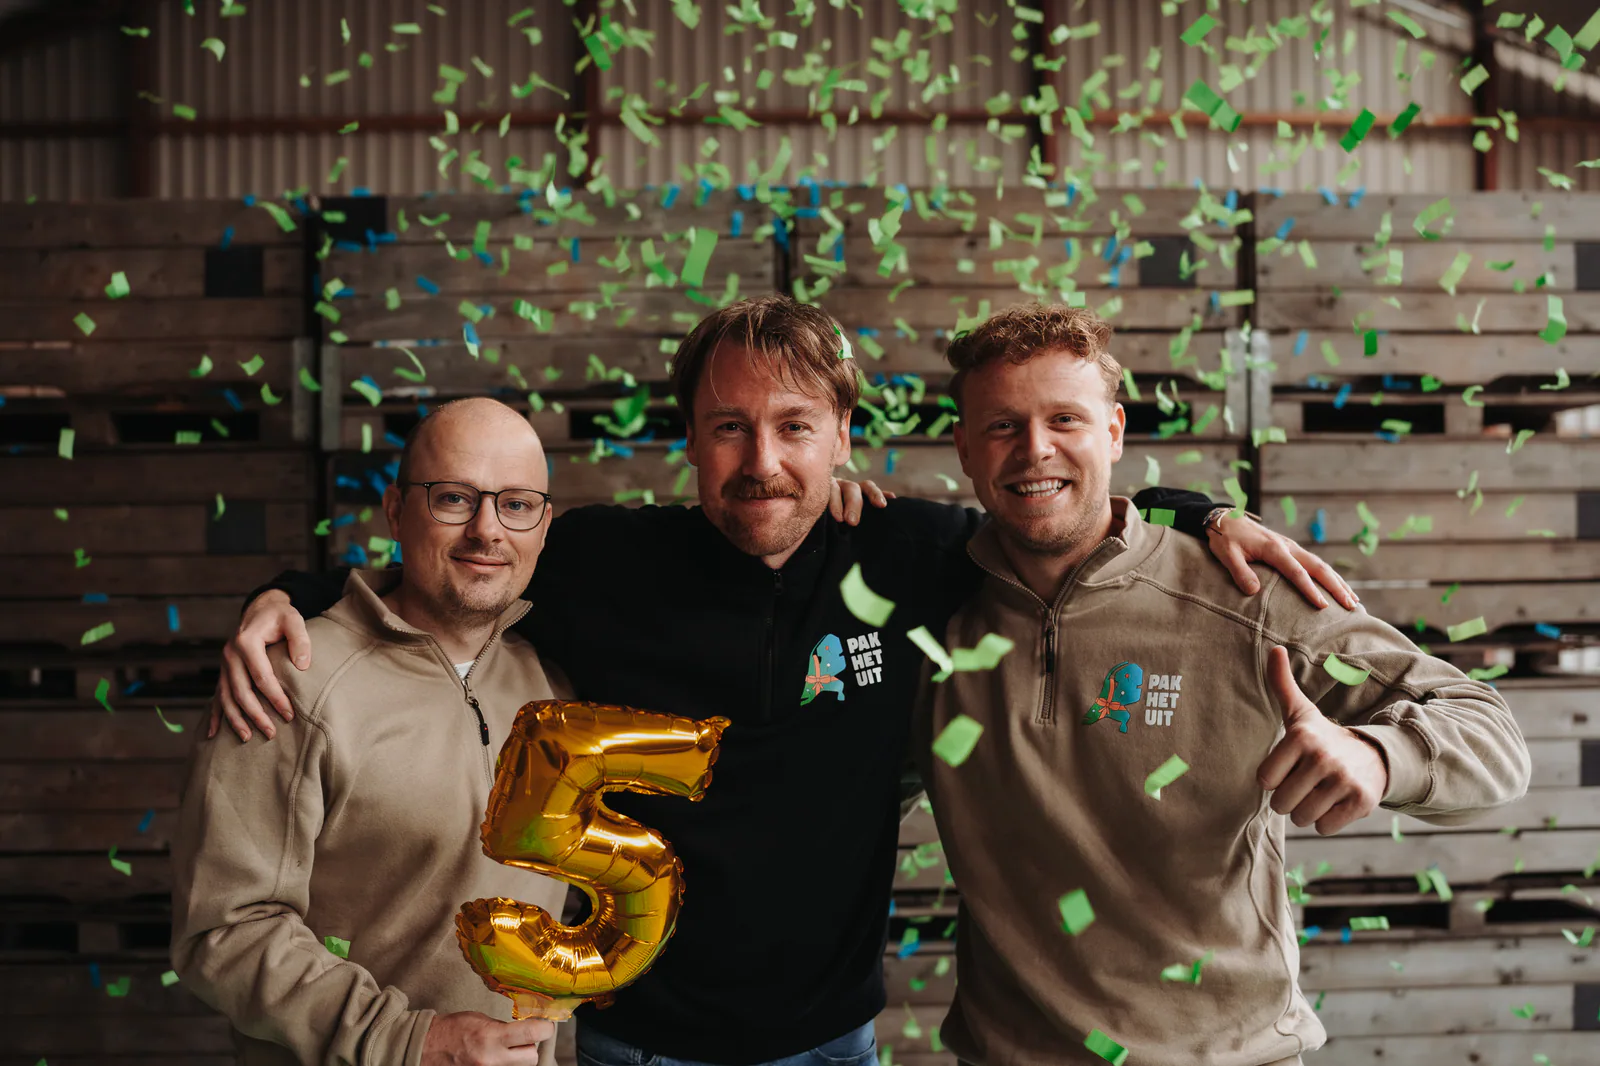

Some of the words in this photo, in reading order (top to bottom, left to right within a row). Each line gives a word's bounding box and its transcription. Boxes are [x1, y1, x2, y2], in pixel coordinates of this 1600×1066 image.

[847, 632, 881, 654] PAK
[851, 649, 882, 670] HET
[855, 667, 882, 686] UIT
[1148, 674, 1182, 690] PAK
[1146, 692, 1179, 708] HET
[1145, 709, 1173, 726] UIT
[454, 700, 731, 1000] 5
